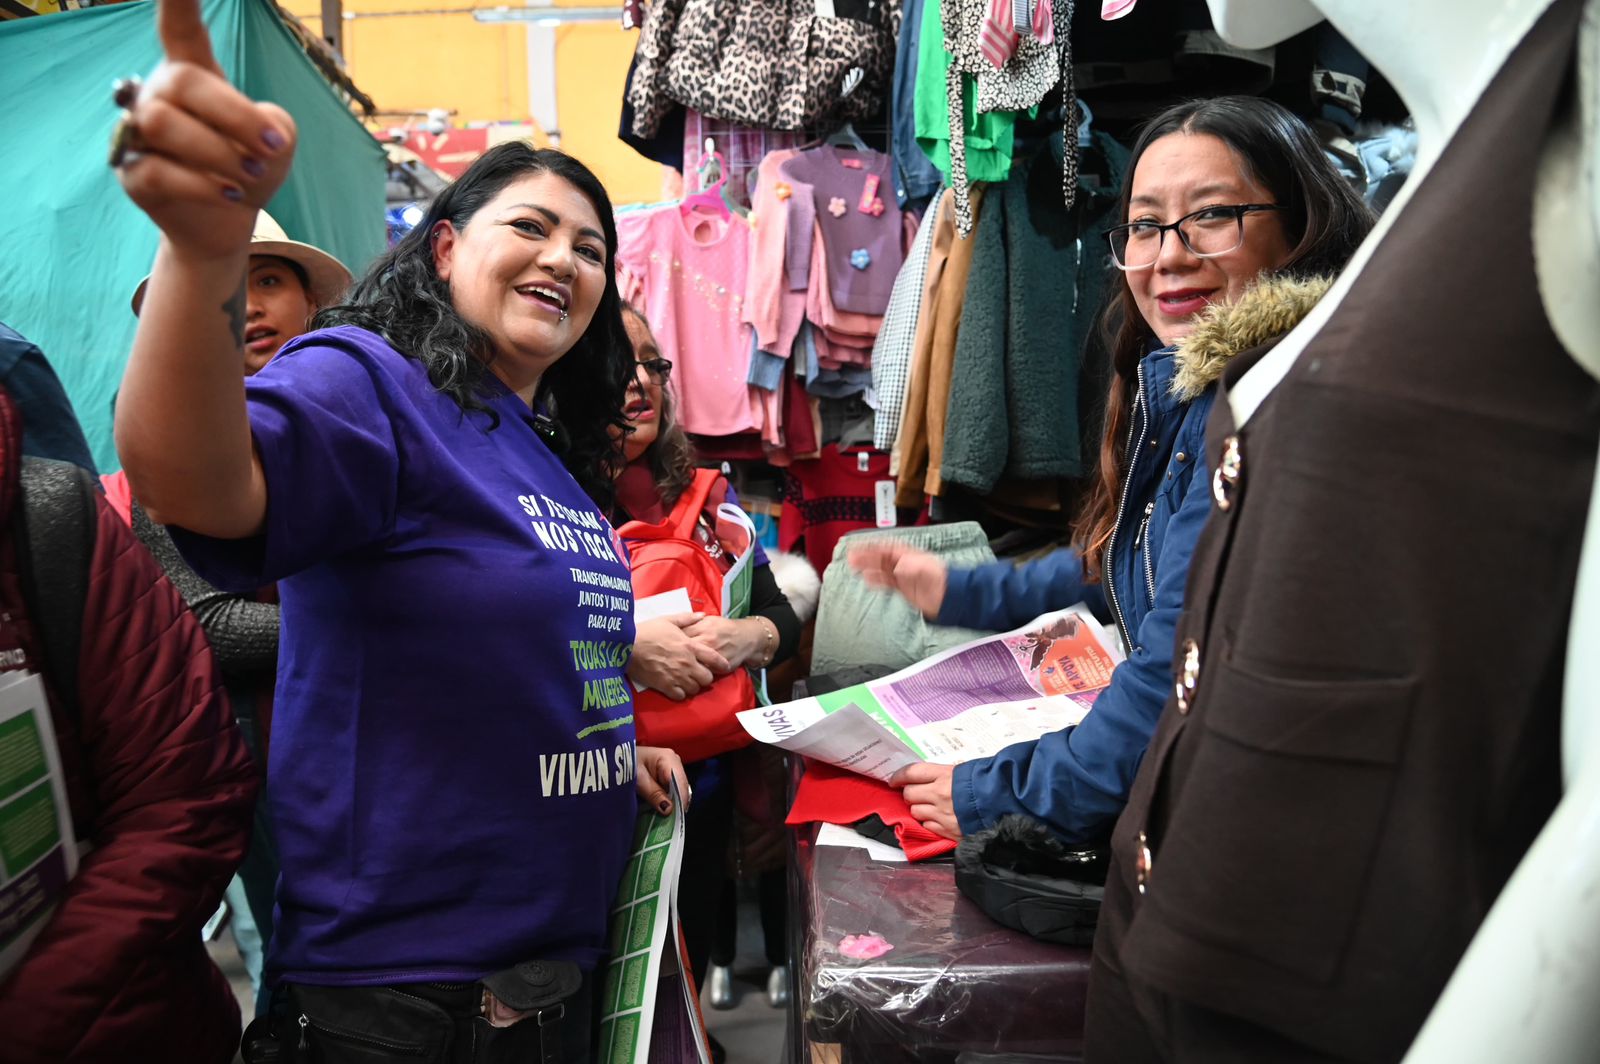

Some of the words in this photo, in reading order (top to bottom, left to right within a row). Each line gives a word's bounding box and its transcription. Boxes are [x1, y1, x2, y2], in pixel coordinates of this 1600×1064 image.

[518, 494, 543, 517] SI
[540, 494, 566, 519] TE
[555, 502, 603, 531] TOCAN
[531, 521, 579, 553] NOS
[574, 528, 619, 563] TOCA
[569, 567, 631, 593] TRANSFORMARNOS
[577, 590, 604, 608] JUNTOS
[604, 594, 610, 609] Y
[610, 595, 630, 612] JUNTAS
[588, 613, 607, 629] PARA
[607, 616, 622, 632] QUE
[569, 640, 606, 671] TODAS
[605, 641, 634, 668] LAS
[1057, 655, 1080, 681] APOYA
[582, 676, 630, 711] MUJERES
[539, 747, 609, 798] VIVAN
[614, 741, 633, 785] SIN
